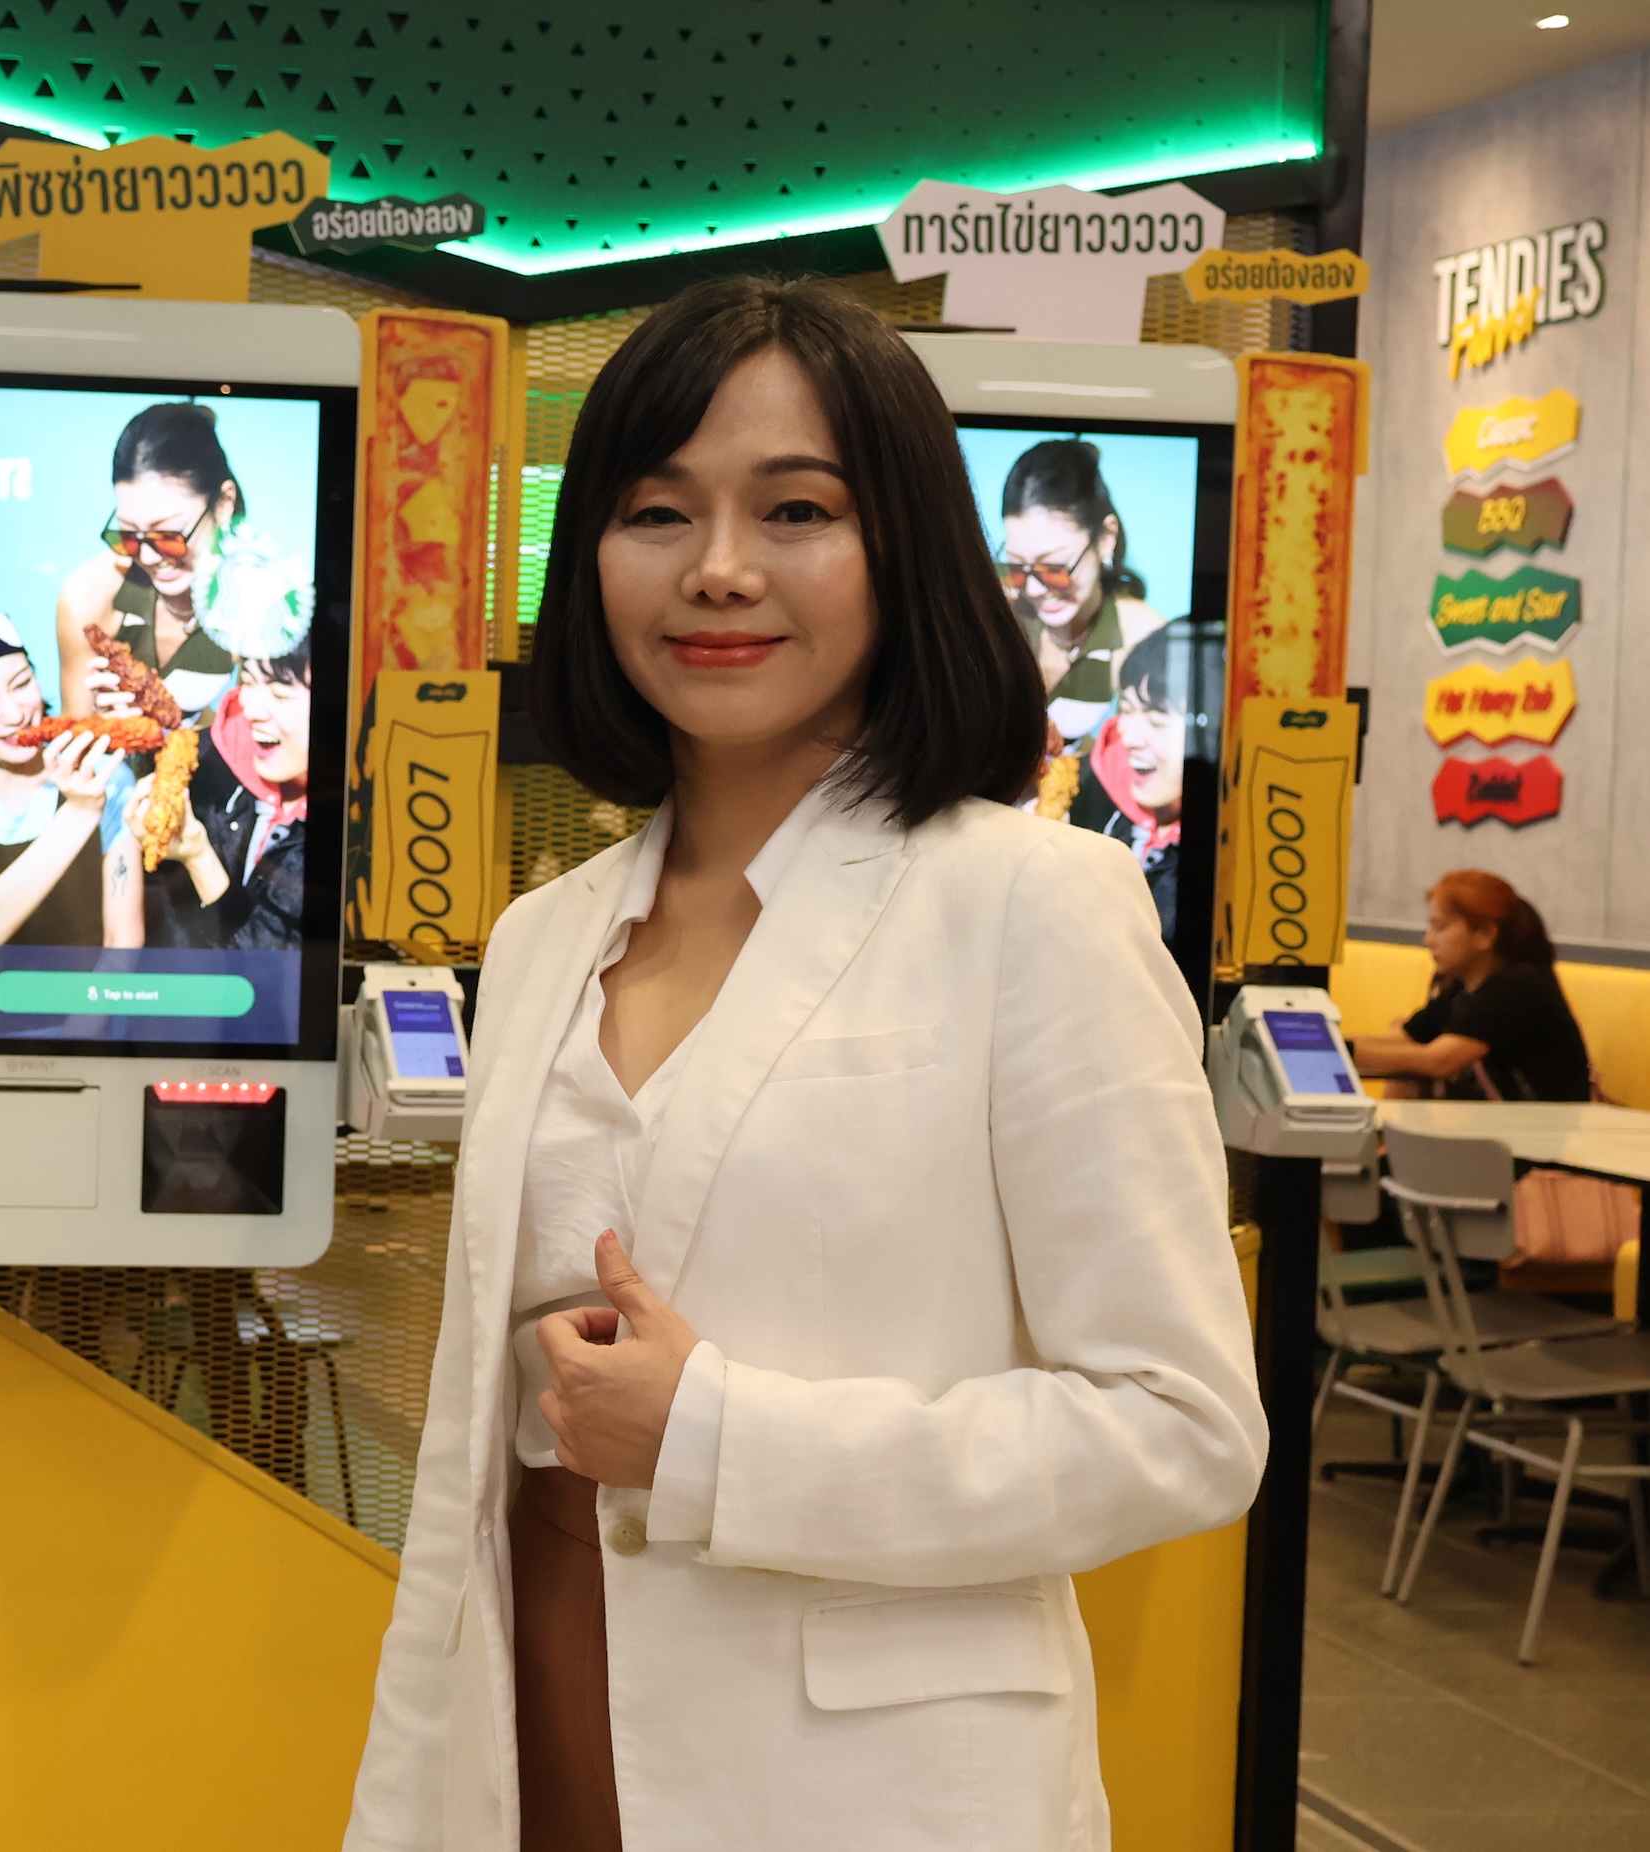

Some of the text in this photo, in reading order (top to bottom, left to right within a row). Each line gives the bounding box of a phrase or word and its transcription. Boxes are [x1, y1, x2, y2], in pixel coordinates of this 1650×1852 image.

[312, 201, 473, 242] อร่อยต้องลอง
[903, 203, 1204, 254] ทาร์ตไข่ยาววววว
[1205, 260, 1357, 291] อร่อยต้องลอง
[1432, 216, 1608, 349] TENDIES
[208, 1066, 242, 1077] SCAN
